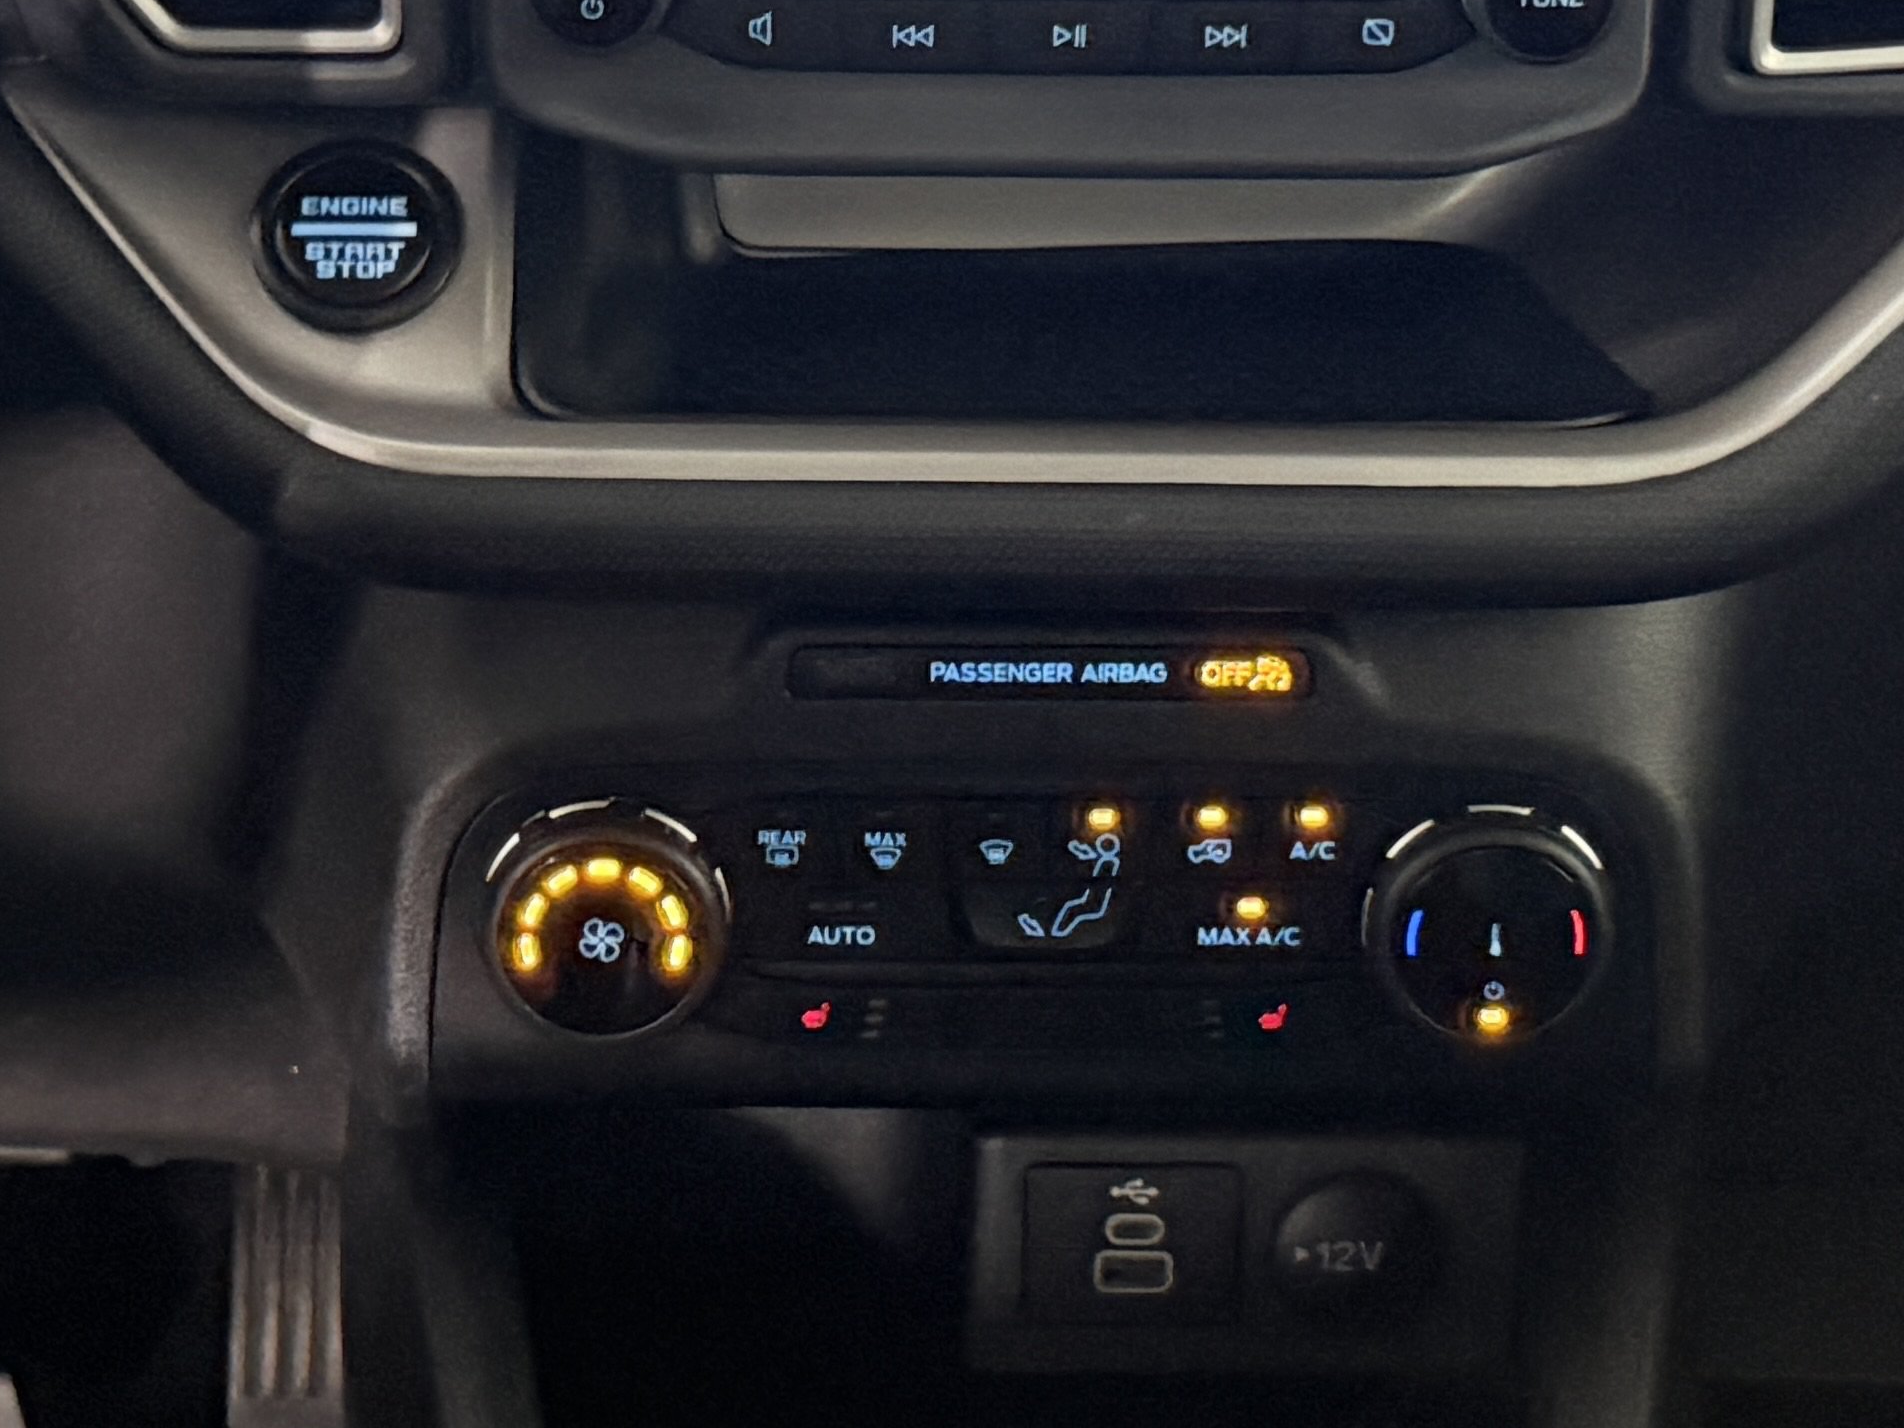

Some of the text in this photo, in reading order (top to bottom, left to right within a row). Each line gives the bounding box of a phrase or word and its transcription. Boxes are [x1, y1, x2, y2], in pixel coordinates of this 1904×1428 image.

[300, 196, 408, 218] ENGINE
[305, 241, 405, 262] START
[315, 261, 395, 279] STOP
[929, 659, 1252, 688] PASSENGER AIRBAG OFF
[758, 830, 807, 846] REAR
[864, 832, 906, 847] MAX
[1290, 841, 1336, 861] A/C
[807, 926, 876, 946] AUTO
[1197, 926, 1301, 947] MAX A/C
